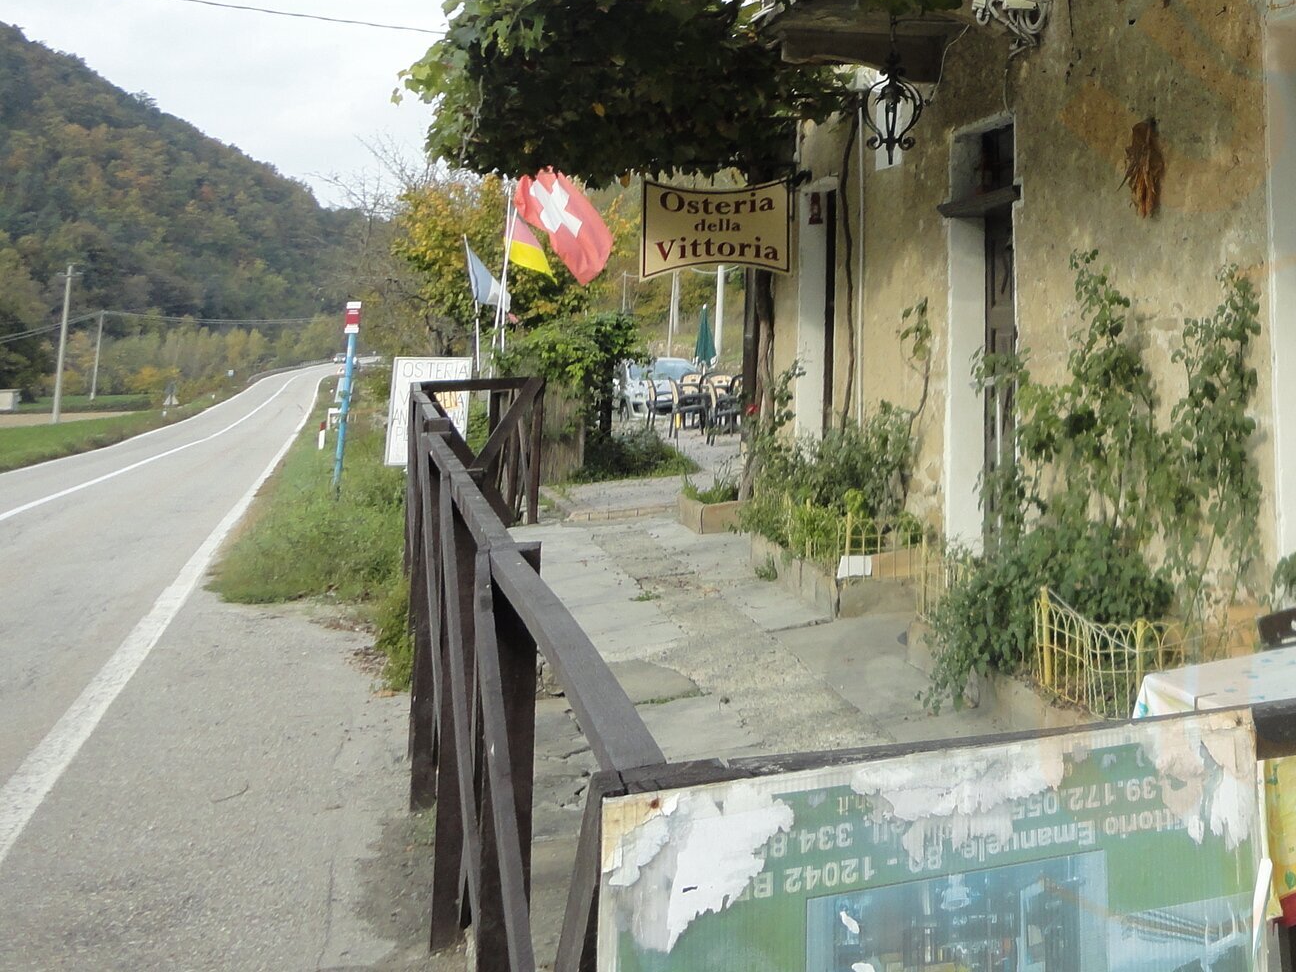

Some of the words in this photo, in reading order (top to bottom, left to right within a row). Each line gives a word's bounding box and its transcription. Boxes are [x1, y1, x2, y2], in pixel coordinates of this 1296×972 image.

[659, 191, 775, 215] Osteria
[694, 218, 741, 232] della
[655, 236, 780, 261] Vittoria
[402, 361, 470, 380] OSTERIA
[1104, 808, 1184, 839] ittorio
[739, 872, 774, 901] B
[783, 856, 875, 893] 12042
